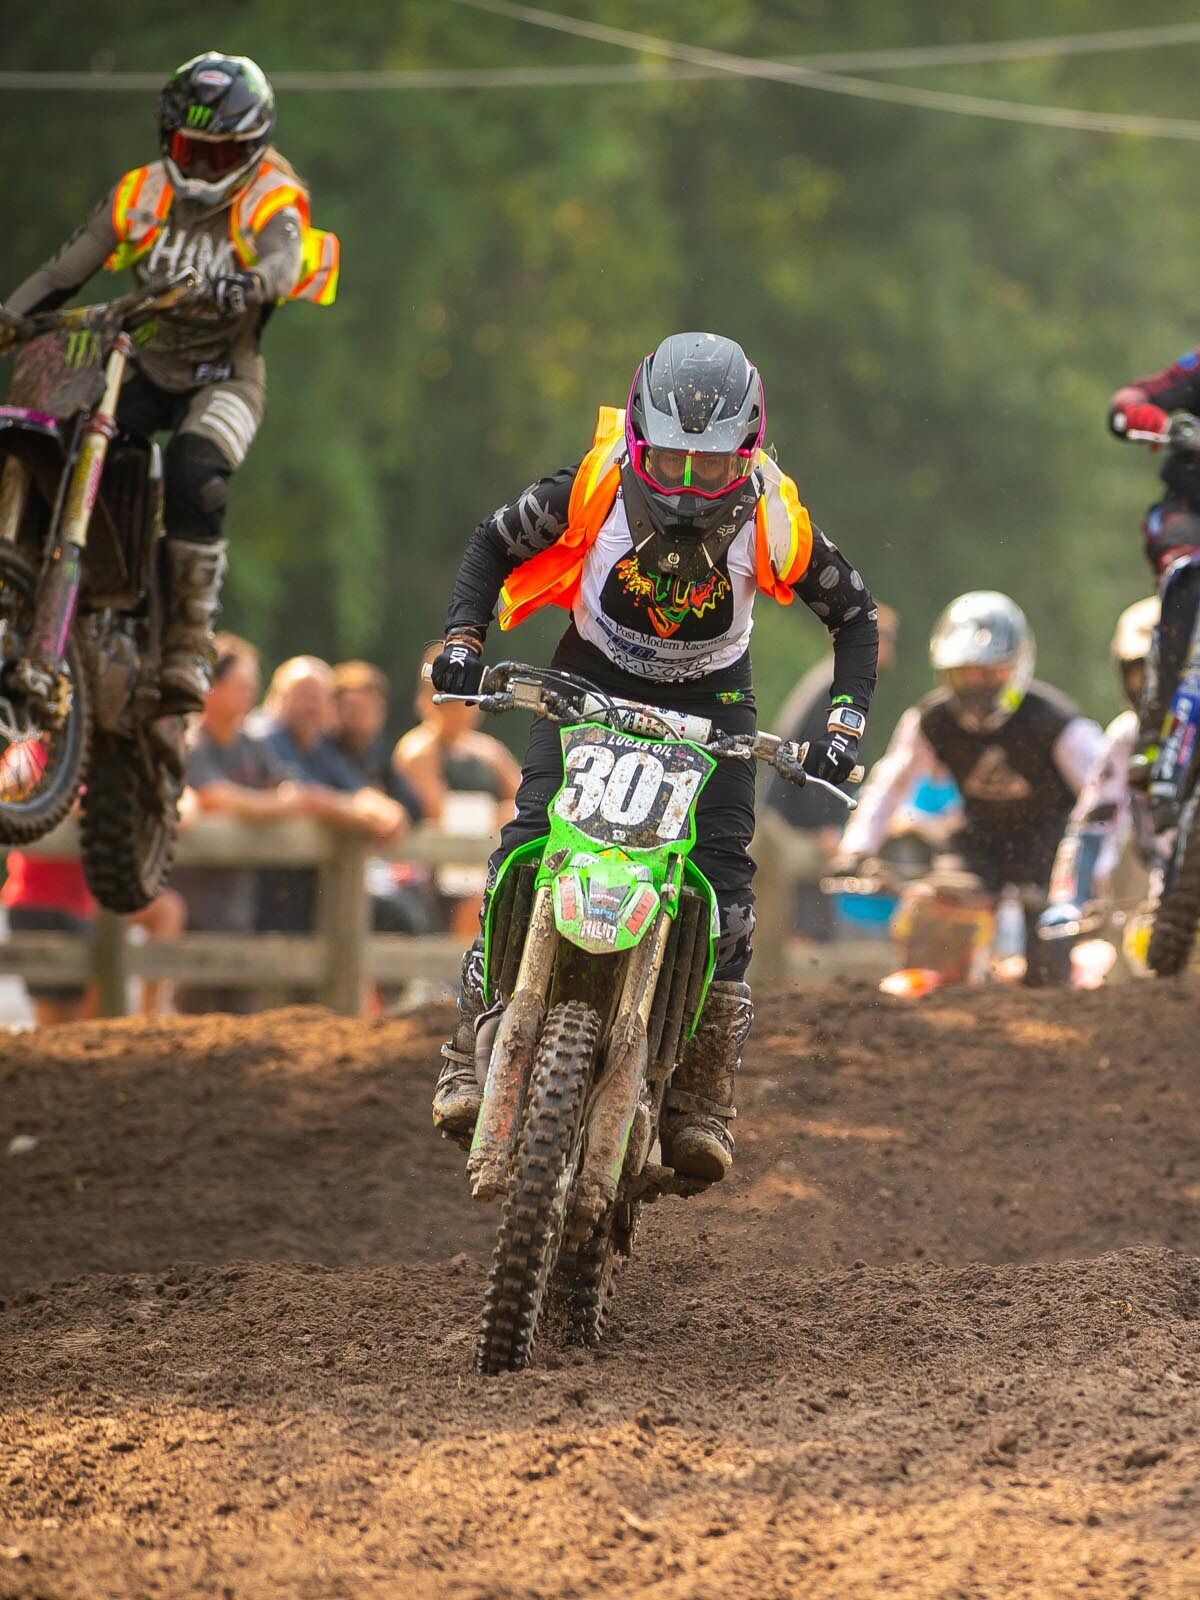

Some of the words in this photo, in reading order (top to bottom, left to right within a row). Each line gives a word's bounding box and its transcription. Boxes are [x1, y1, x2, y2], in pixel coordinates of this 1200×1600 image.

[616, 622, 680, 651] Post-Modern
[449, 646, 469, 668] FOX
[607, 735, 651, 751] LUCAS
[651, 742, 673, 757] OIL
[826, 733, 849, 766] FOX
[554, 744, 703, 840] 301
